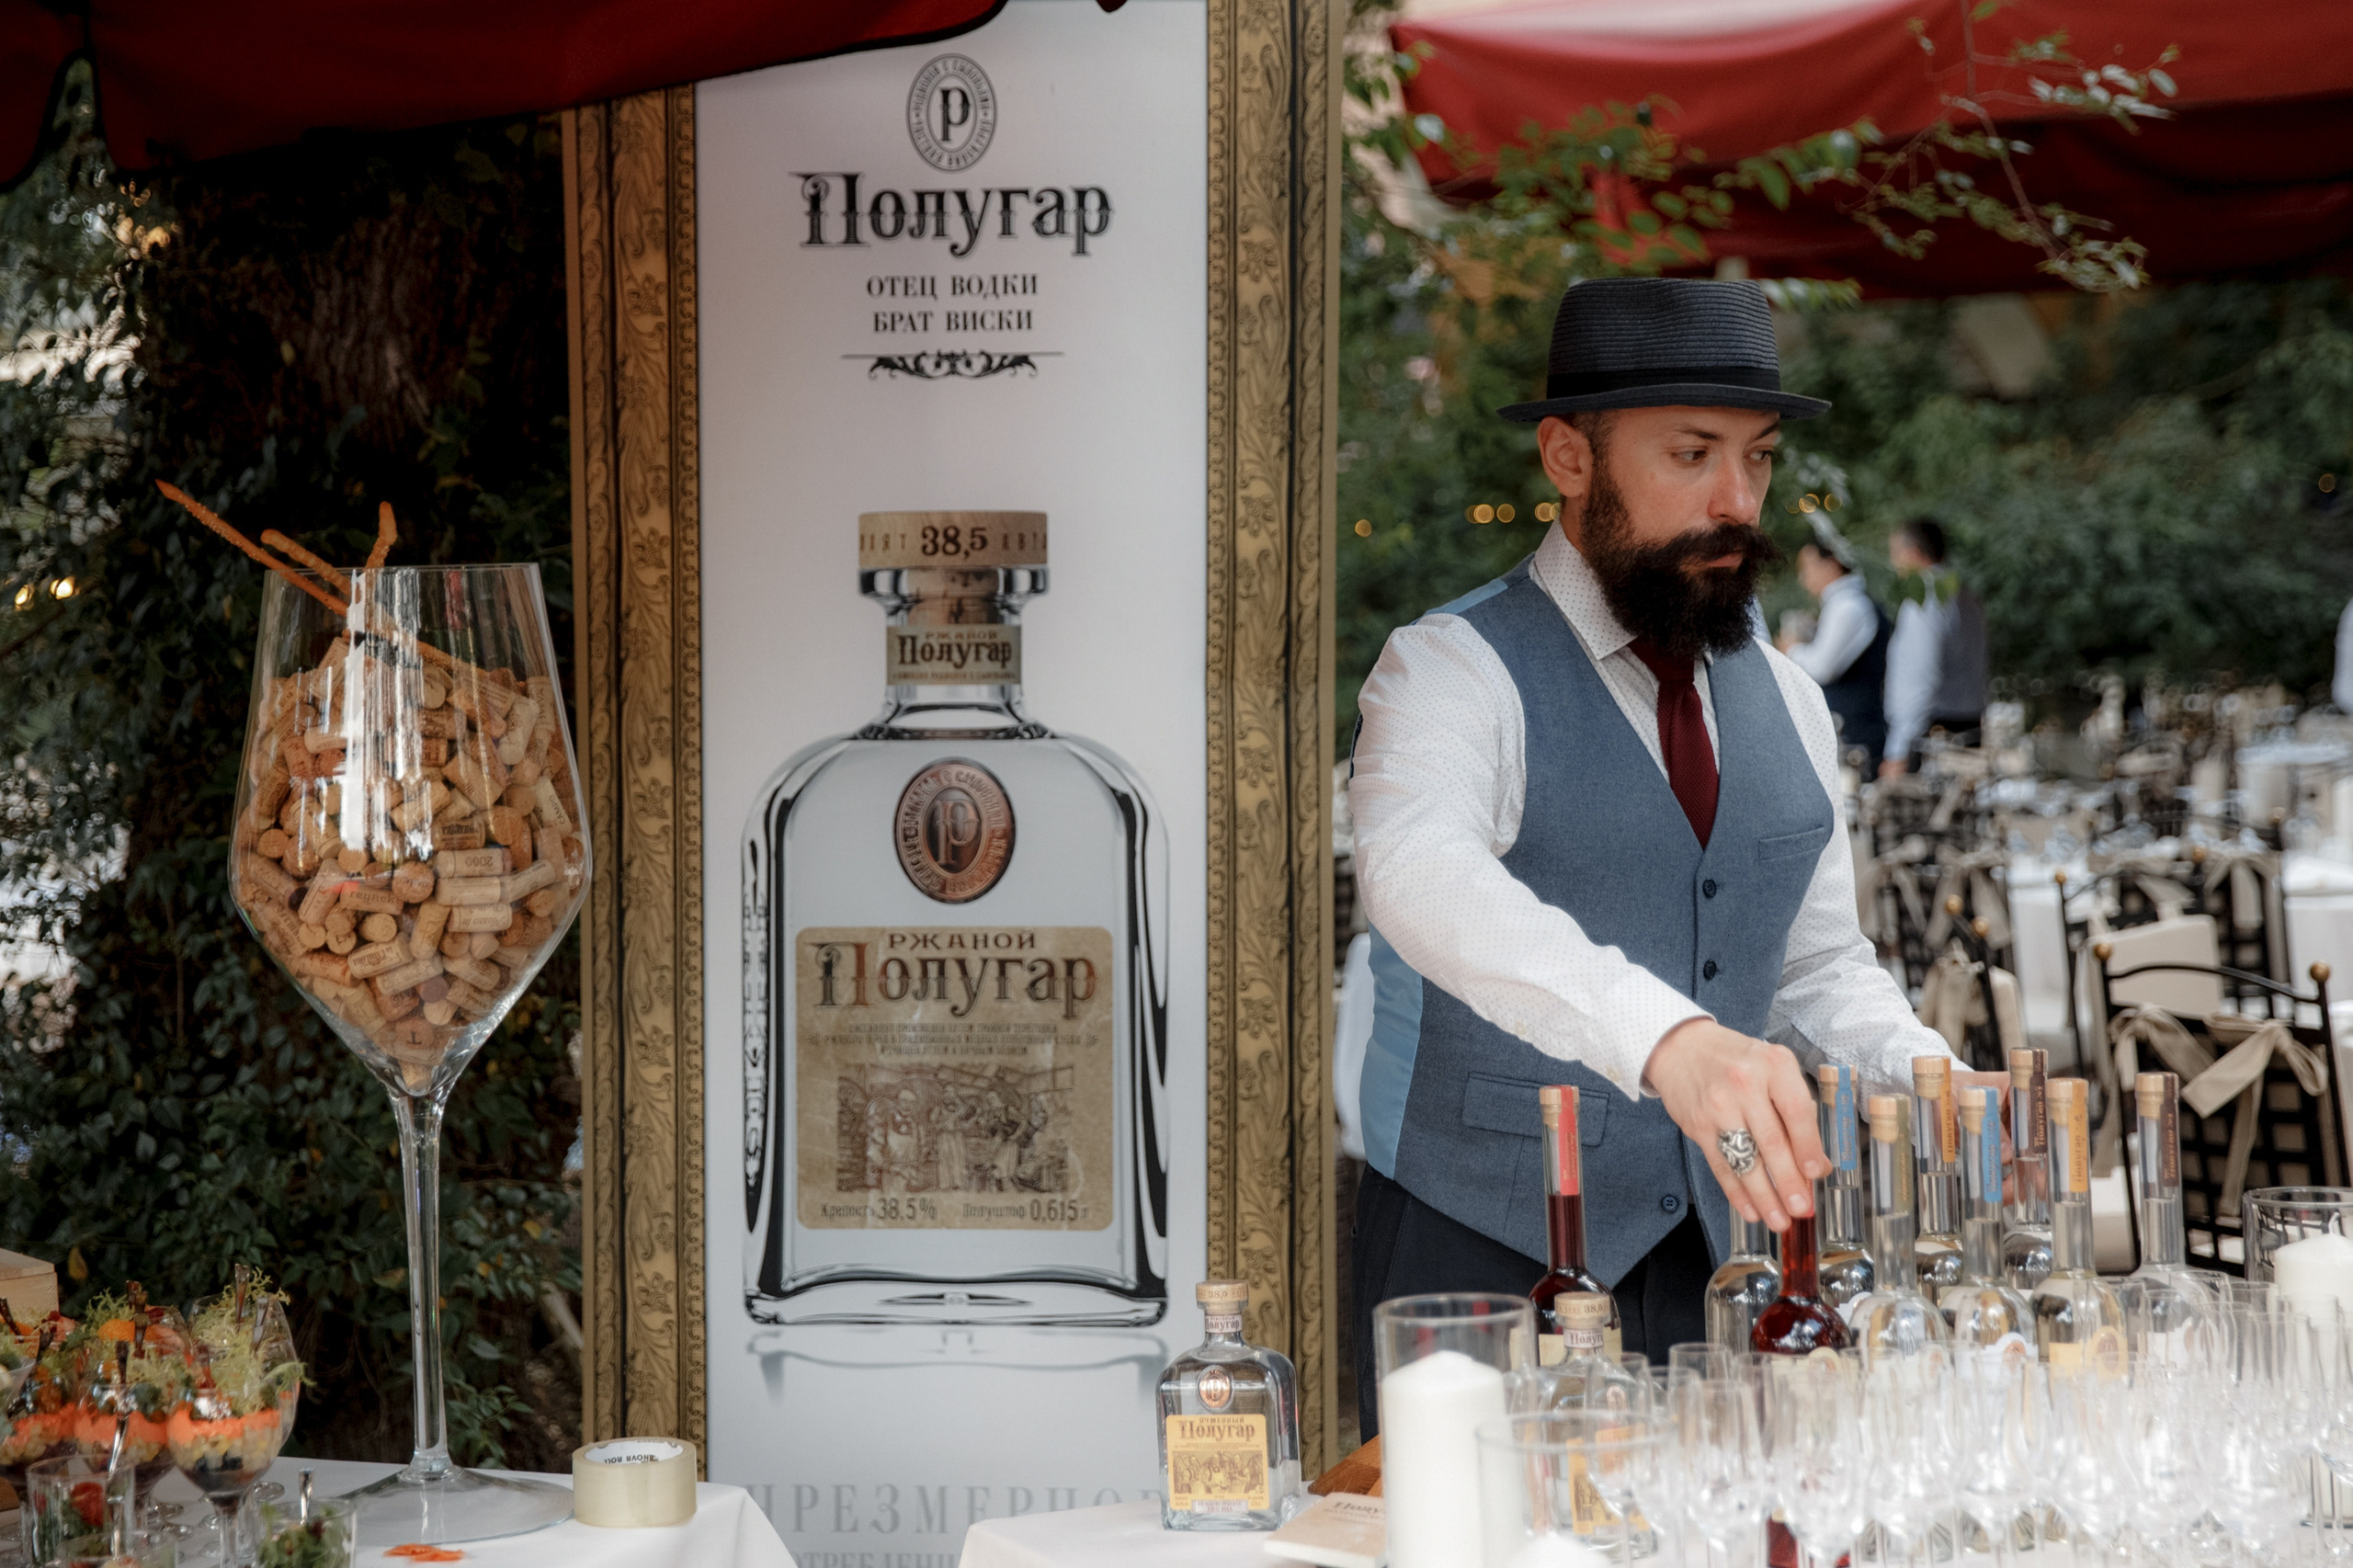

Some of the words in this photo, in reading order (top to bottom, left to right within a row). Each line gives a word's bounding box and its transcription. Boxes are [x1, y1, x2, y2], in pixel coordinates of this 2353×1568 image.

[789, 171, 1113, 258] Полугар
[867, 276, 938, 300] ОТЕЦ
[950, 274, 1038, 299] ВОДКИ
[873, 312, 933, 333] БРАТ
[945, 310, 1034, 333] ВИСКИ
[921, 526, 988, 561] 38,5
[897, 634, 1013, 669] Полугар
[549, 795, 566, 825] CAMPO
[466, 856, 494, 867] 2000
[888, 932, 1036, 950] РЖАНОЙ
[804, 941, 1099, 1020] Полугар
[1029, 1198, 1078, 1224] 0,615
[1177, 1420, 1255, 1441] Полугар
